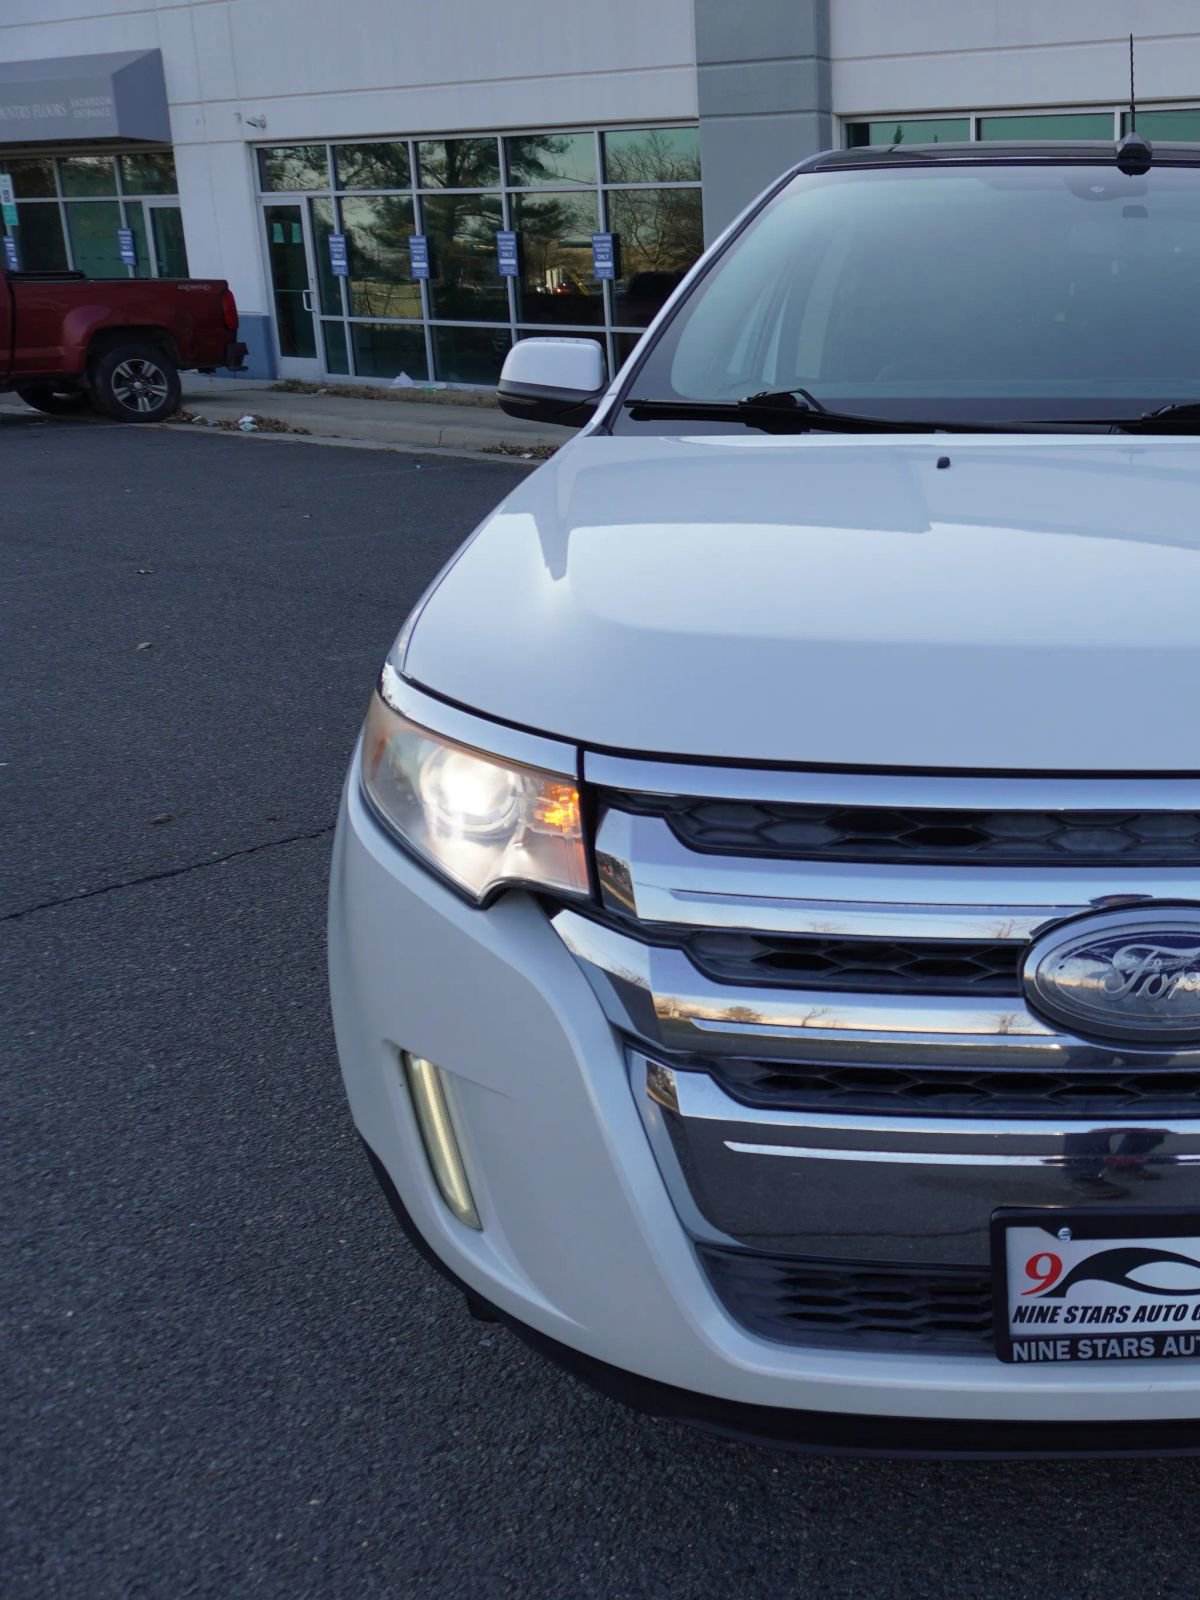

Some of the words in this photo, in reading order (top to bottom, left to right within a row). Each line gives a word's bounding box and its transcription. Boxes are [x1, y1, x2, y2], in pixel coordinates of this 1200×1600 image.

[1021, 1252, 1063, 1295] 9
[1012, 1305, 1062, 1324] NINE
[1064, 1305, 1130, 1324] STARS
[1131, 1303, 1189, 1323] AUTO
[1013, 1340, 1071, 1361] NINE
[1077, 1338, 1155, 1359] STARS
